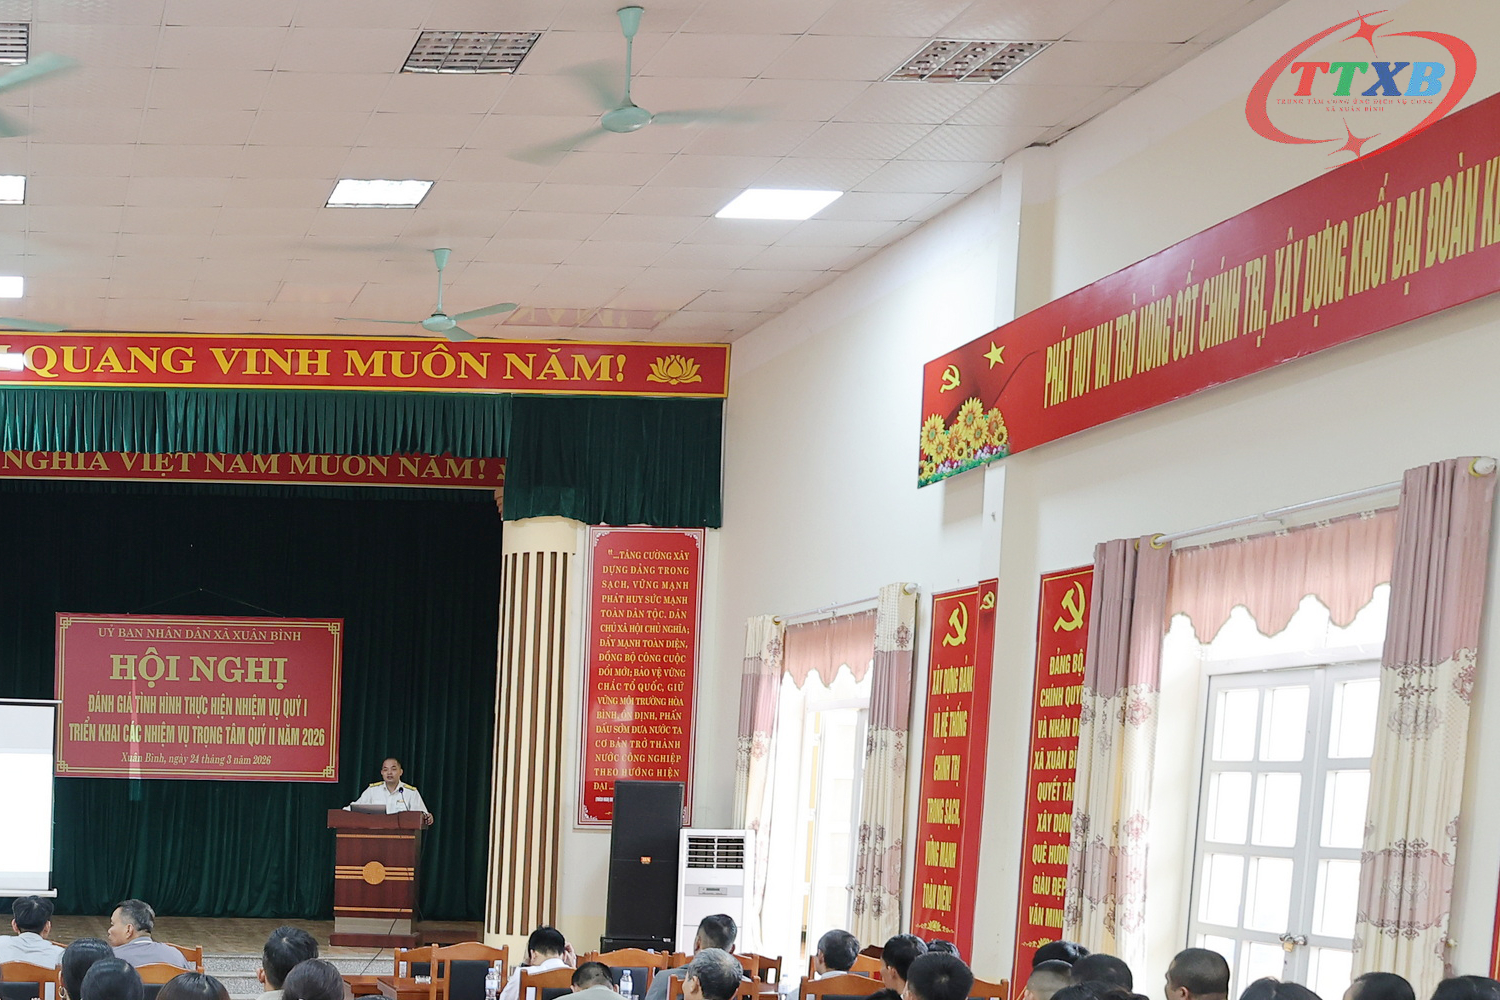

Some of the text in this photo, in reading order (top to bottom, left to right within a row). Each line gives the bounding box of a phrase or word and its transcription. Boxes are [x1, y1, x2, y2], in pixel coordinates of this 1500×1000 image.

[1043, 325, 1072, 409] PHÁT
[1071, 327, 1094, 399] HUY
[1113, 293, 1136, 383] TRÒ
[1172, 259, 1200, 362] CỐT
[1199, 256, 1242, 352] CHÍNH
[1243, 254, 1268, 348] TRỊ,
[1270, 226, 1303, 325] XÂY
[1303, 219, 1348, 327] DỰNG
[1348, 172, 1392, 296] KHỐI
[1391, 187, 1425, 295] ĐẠI
[1425, 152, 1481, 268] ĐOÀN
[23, 344, 196, 378] QUANG
[209, 347, 331, 376] VINH
[343, 344, 490, 379] MUÔN
[503, 347, 626, 383] NĂM!
[658, 566, 689, 575] TRONG
[117, 628, 144, 638] BAN
[146, 626, 182, 639] NHÂN
[185, 627, 212, 639] DÂN
[214, 627, 231, 640] XÃ
[232, 628, 267, 640] XUÂN
[270, 628, 301, 641] BÌNH
[109, 646, 288, 690] HỘI NGHỊ
[88, 690, 308, 720] ĐÁNH GIÁ TÌNH HÌNH THỰC HIỆN NHIỆM VỤ QUÝ I
[68, 716, 325, 748] TRIỂN KHAI CÁC NHIỆM VỤ TRỌNG TÂM QUÝ II NĂM 2026
[121, 752, 143, 763] Xuân
[144, 752, 167, 764] Bình,
[168, 754, 188, 765] ngày
[189, 753, 199, 764] 24
[201, 754, 225, 766] tháng
[226, 755, 232, 764] 3
[252, 755, 272, 765] 2026
